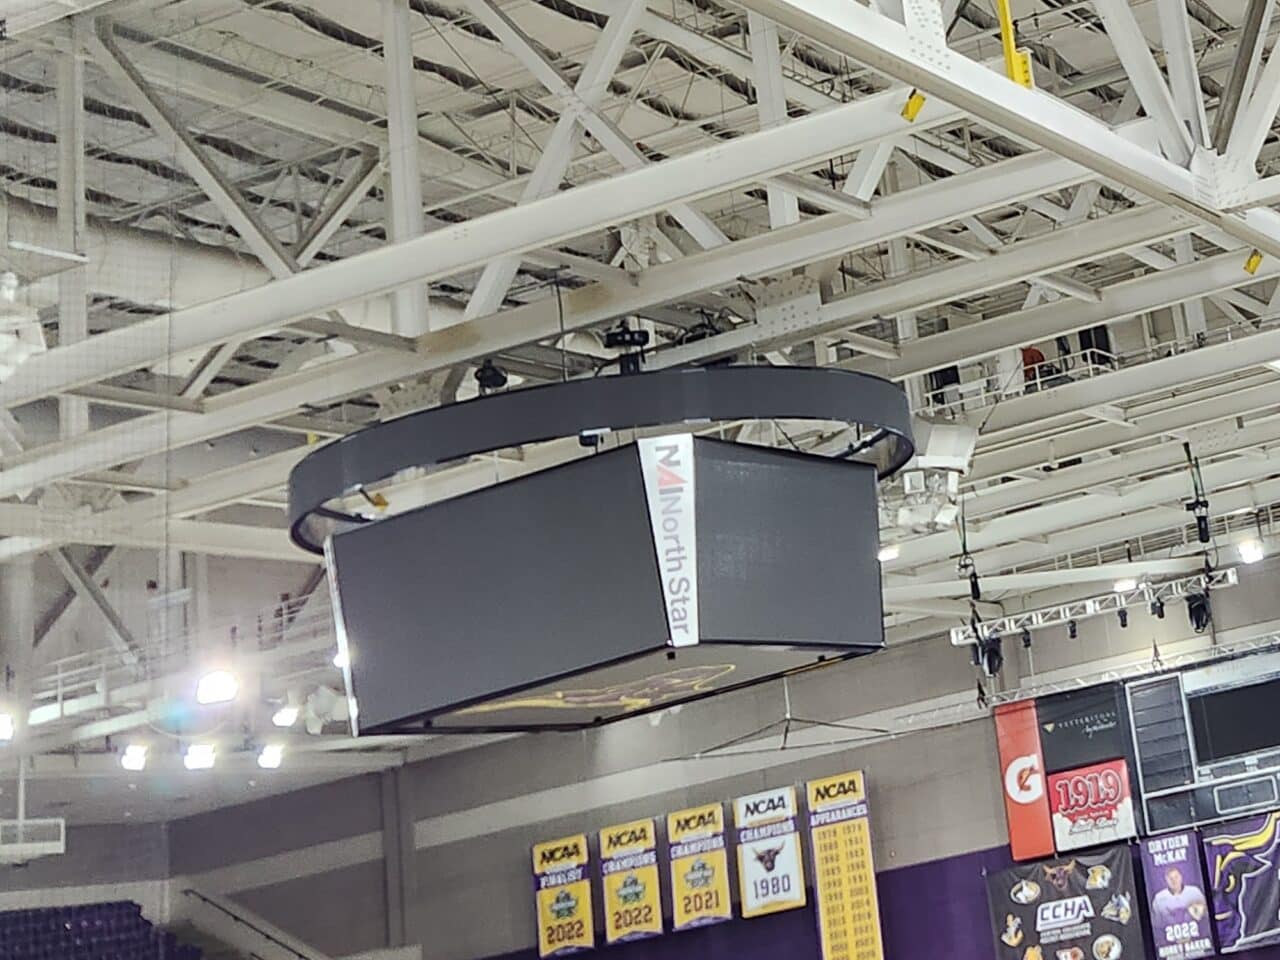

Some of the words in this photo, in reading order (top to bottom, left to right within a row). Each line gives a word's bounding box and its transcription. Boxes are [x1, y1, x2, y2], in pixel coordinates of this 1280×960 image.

[660, 495, 687, 572] North
[668, 577, 690, 634] Star
[814, 779, 858, 802] NCAA
[1005, 753, 1043, 804] G
[1056, 768, 1121, 814] 1919
[744, 796, 786, 818] NCAA
[675, 810, 716, 833] NCAA
[607, 828, 648, 849] NCAA
[540, 843, 581, 865] NCAA
[754, 874, 791, 899] 1980
[683, 890, 720, 915] 2021
[1040, 897, 1093, 921] CCHA
[614, 905, 653, 929] 2022
[546, 919, 585, 944] 2022
[1165, 921, 1199, 942] 2022
